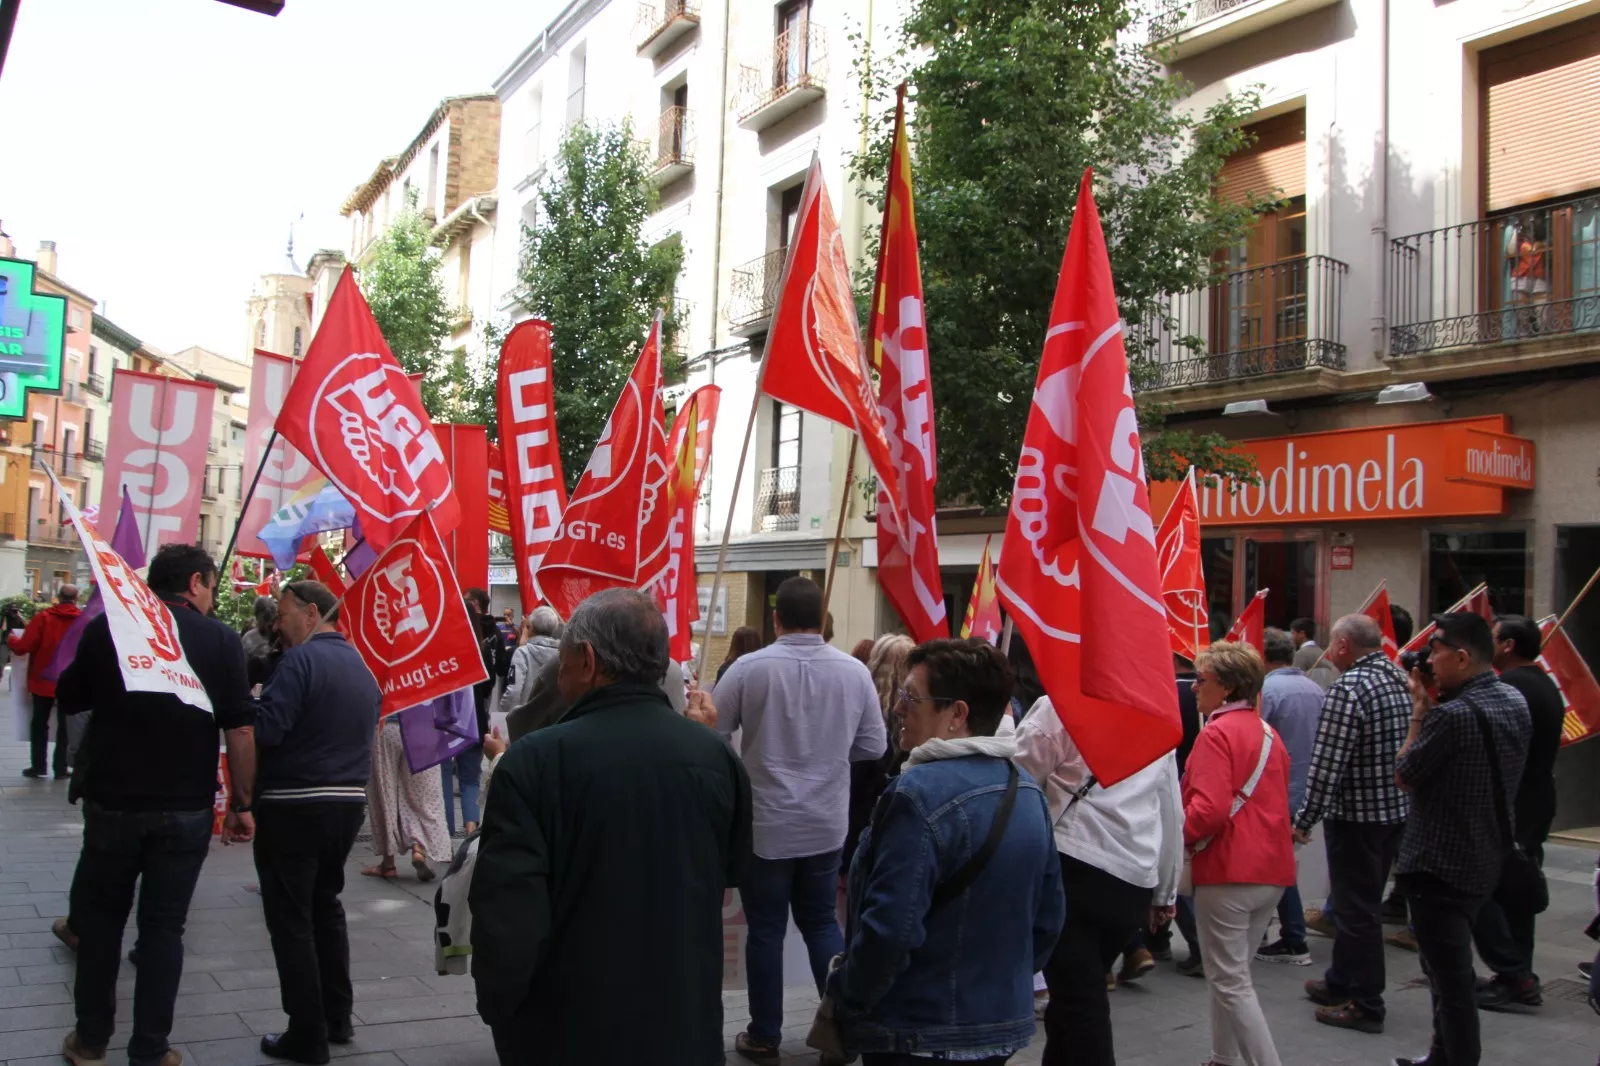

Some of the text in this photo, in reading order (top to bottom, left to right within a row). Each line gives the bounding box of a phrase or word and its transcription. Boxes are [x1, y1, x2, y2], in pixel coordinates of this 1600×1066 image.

[352, 367, 445, 484] UGT
[1467, 440, 1532, 481] modimela
[1203, 434, 1425, 520] modimela
